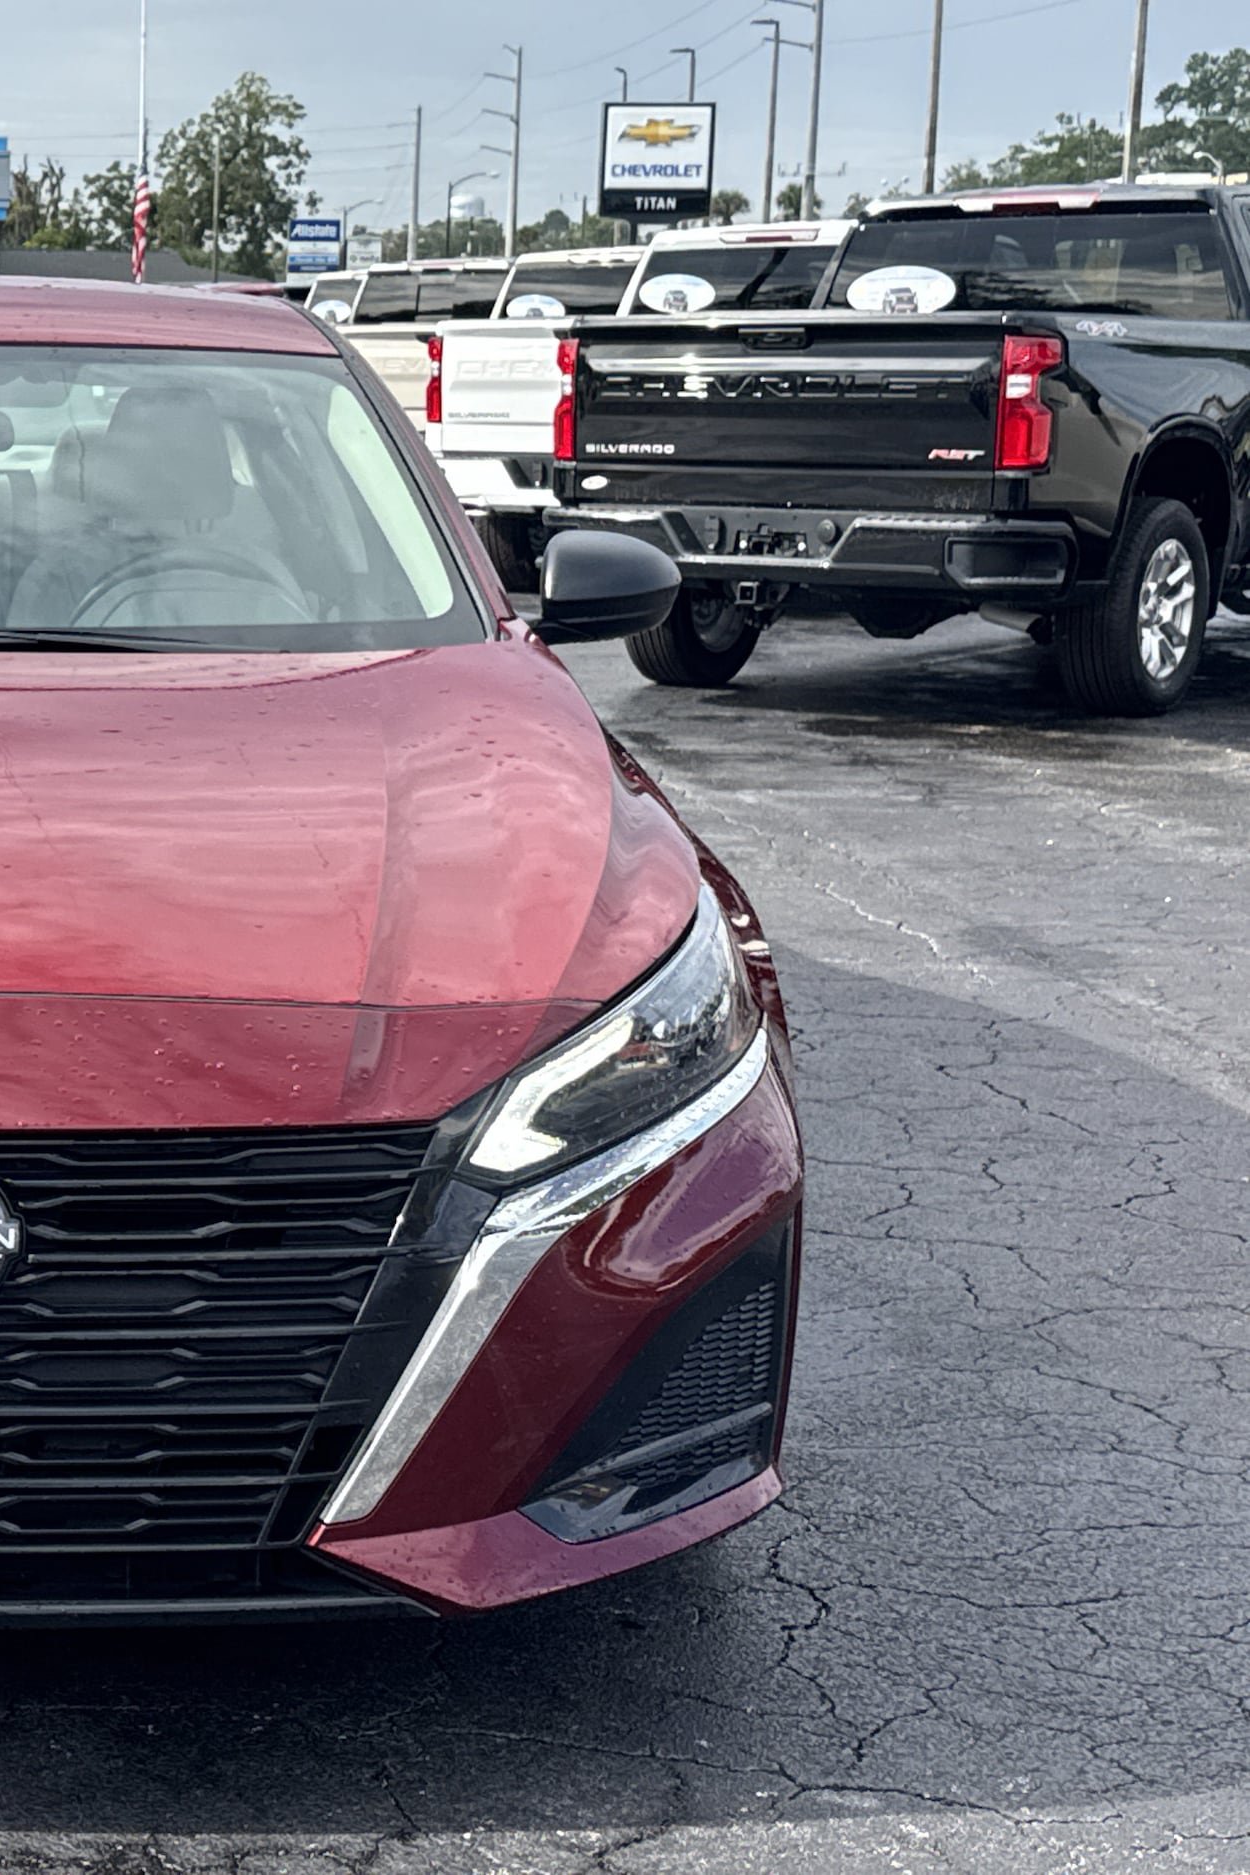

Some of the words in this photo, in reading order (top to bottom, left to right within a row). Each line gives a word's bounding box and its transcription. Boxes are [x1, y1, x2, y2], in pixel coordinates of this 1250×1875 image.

[611, 164, 703, 177] CHEVROLET
[634, 196, 677, 211] TITAN
[291, 223, 338, 238] Allstate
[600, 374, 972, 399] CHEVROLET
[585, 443, 675, 455] SILVERADO
[928, 448, 986, 461] RST
